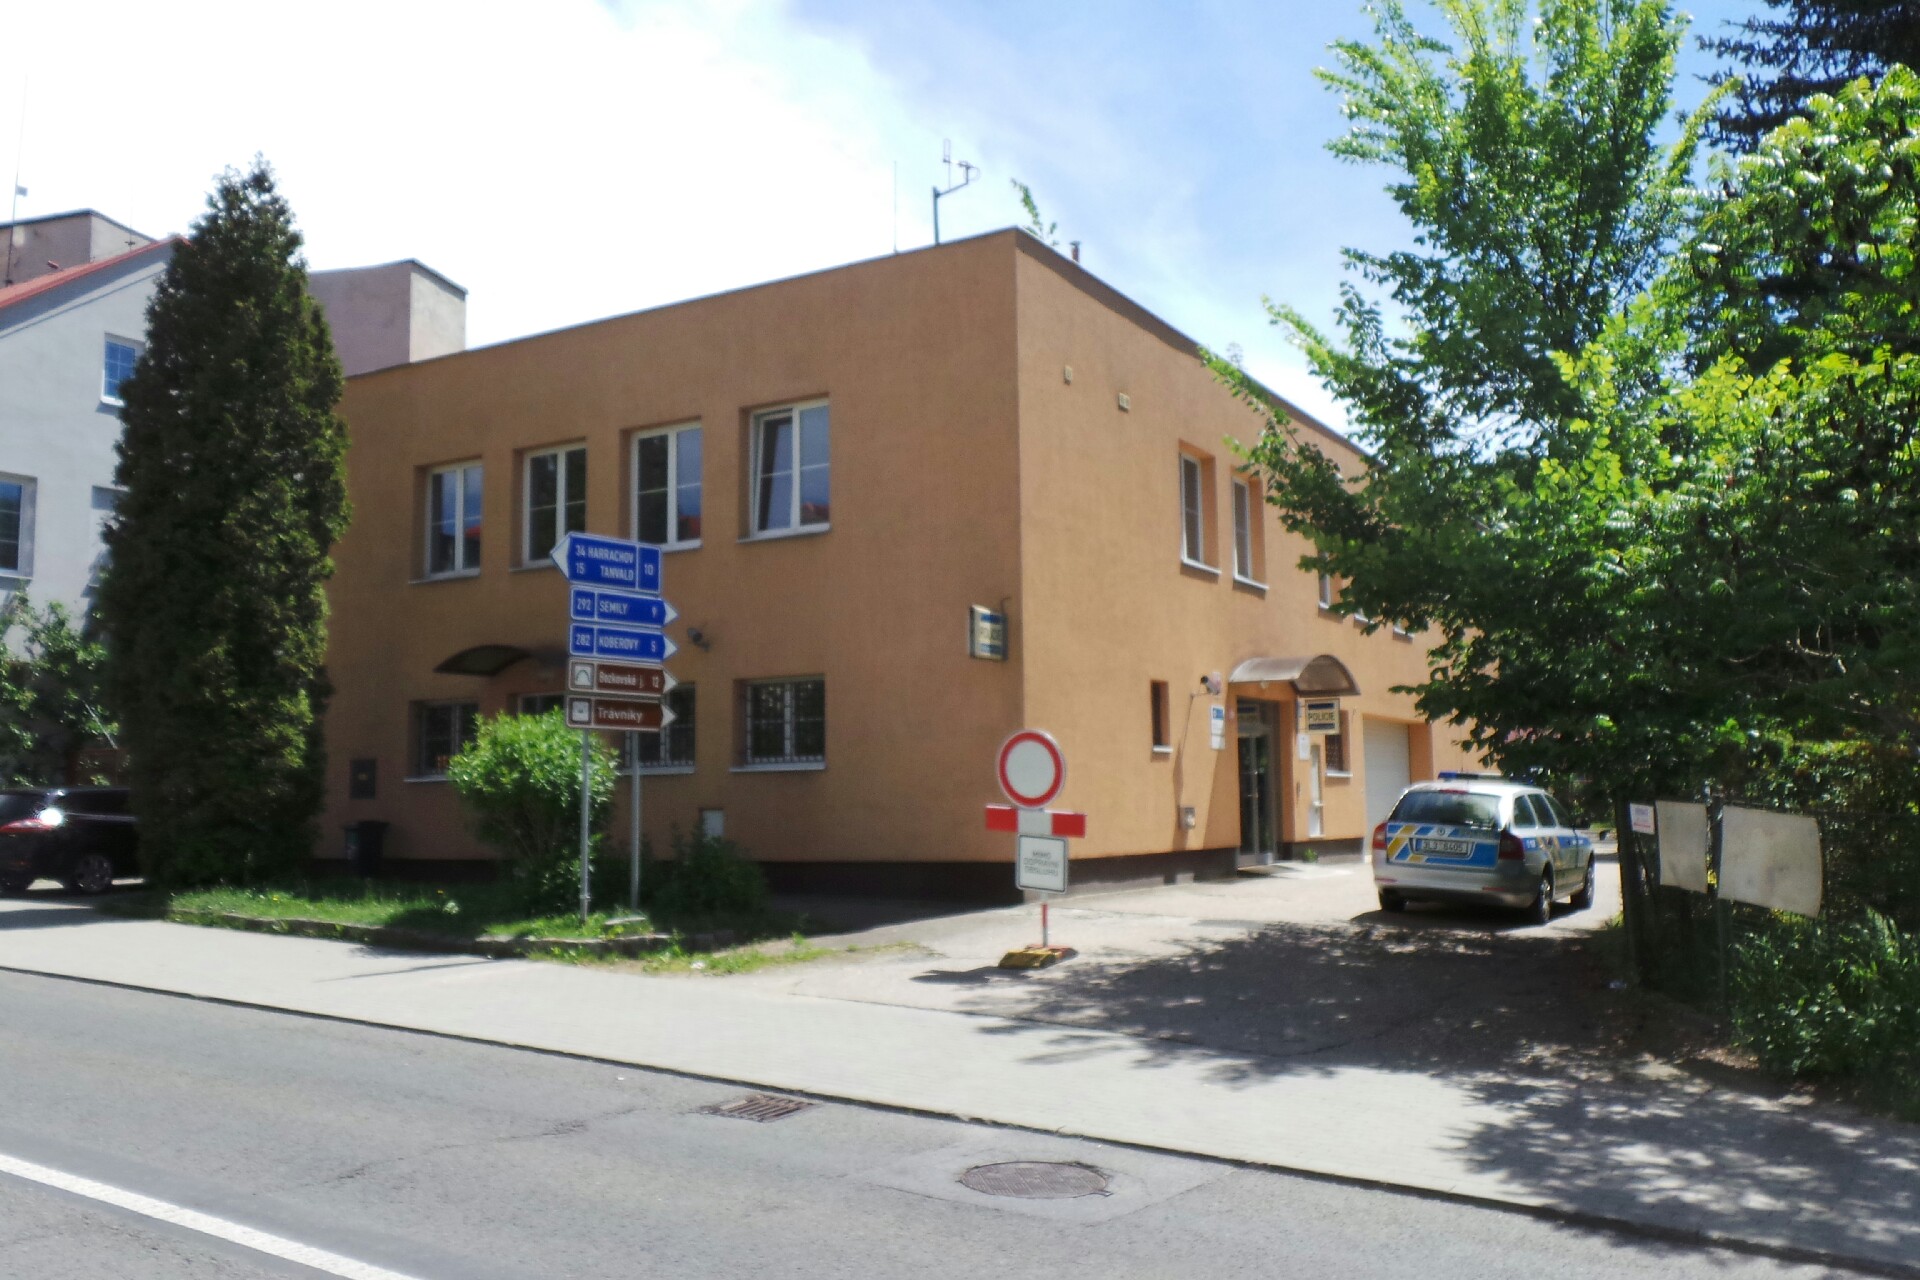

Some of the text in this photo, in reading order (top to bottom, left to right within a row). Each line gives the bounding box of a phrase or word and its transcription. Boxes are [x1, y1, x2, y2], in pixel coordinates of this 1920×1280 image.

[575, 544, 634, 564] 34 HARRACHOV
[576, 562, 634, 581] 15 TANVALD
[644, 563, 654, 576] 10
[577, 598, 592, 611] 292
[599, 600, 629, 614] SEMILY
[599, 635, 639, 651] KOBEROVY
[1308, 711, 1335, 721] POLICIE
